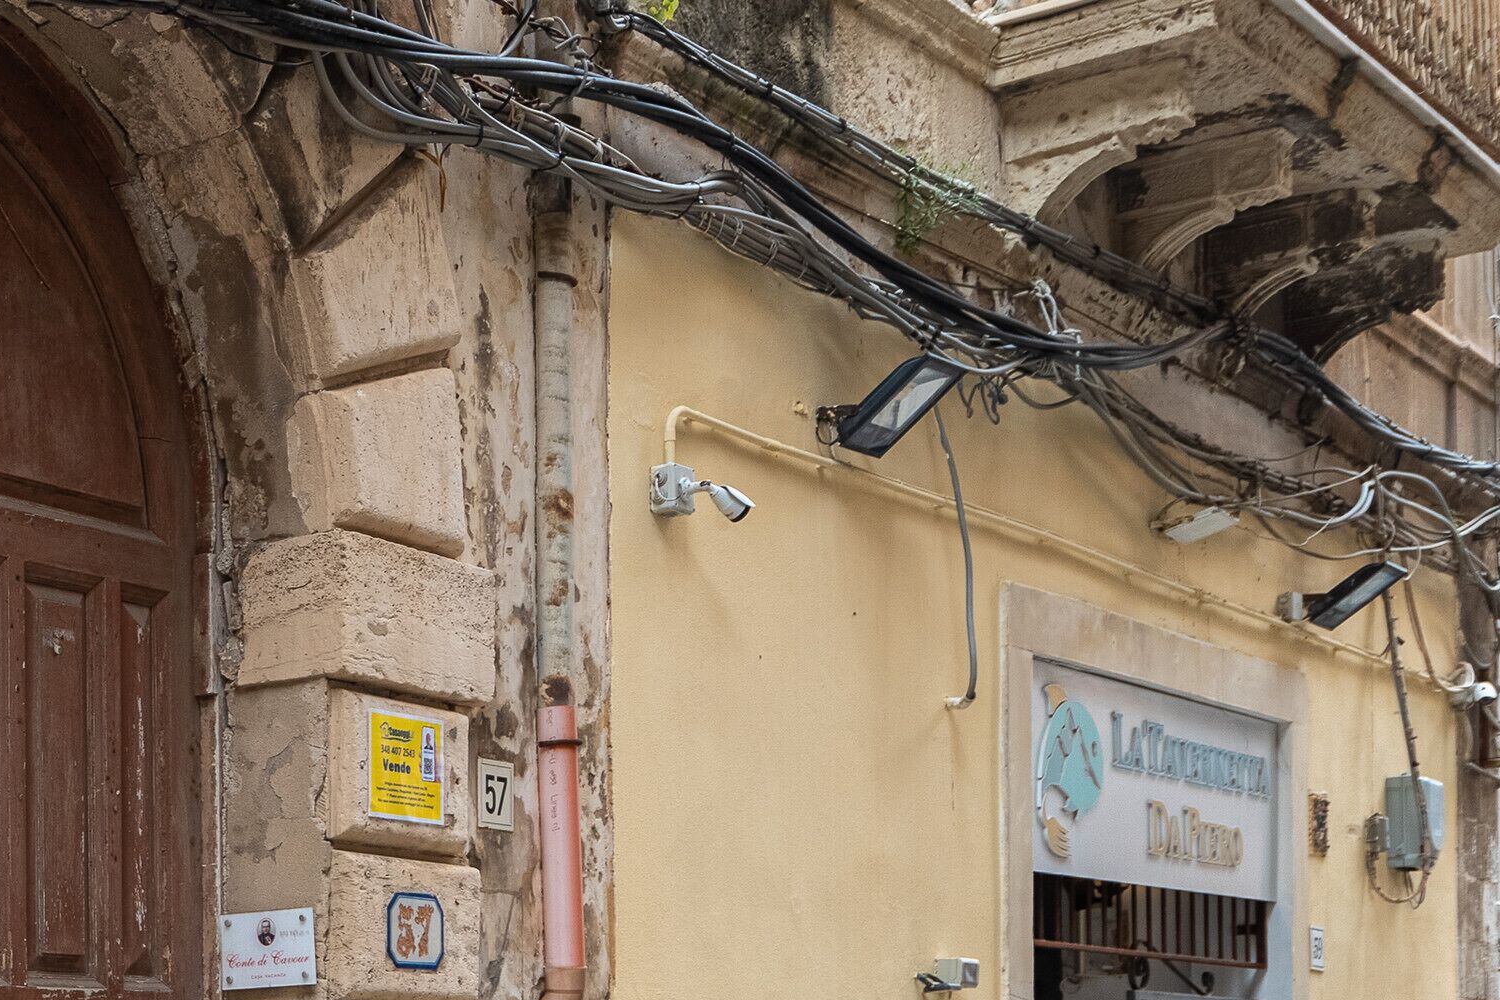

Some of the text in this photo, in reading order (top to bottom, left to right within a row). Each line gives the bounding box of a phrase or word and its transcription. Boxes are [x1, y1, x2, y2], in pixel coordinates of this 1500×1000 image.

[383, 758, 411, 774] Vende
[485, 774, 508, 816] 57
[226, 950, 309, 969] Conte di Cavour
